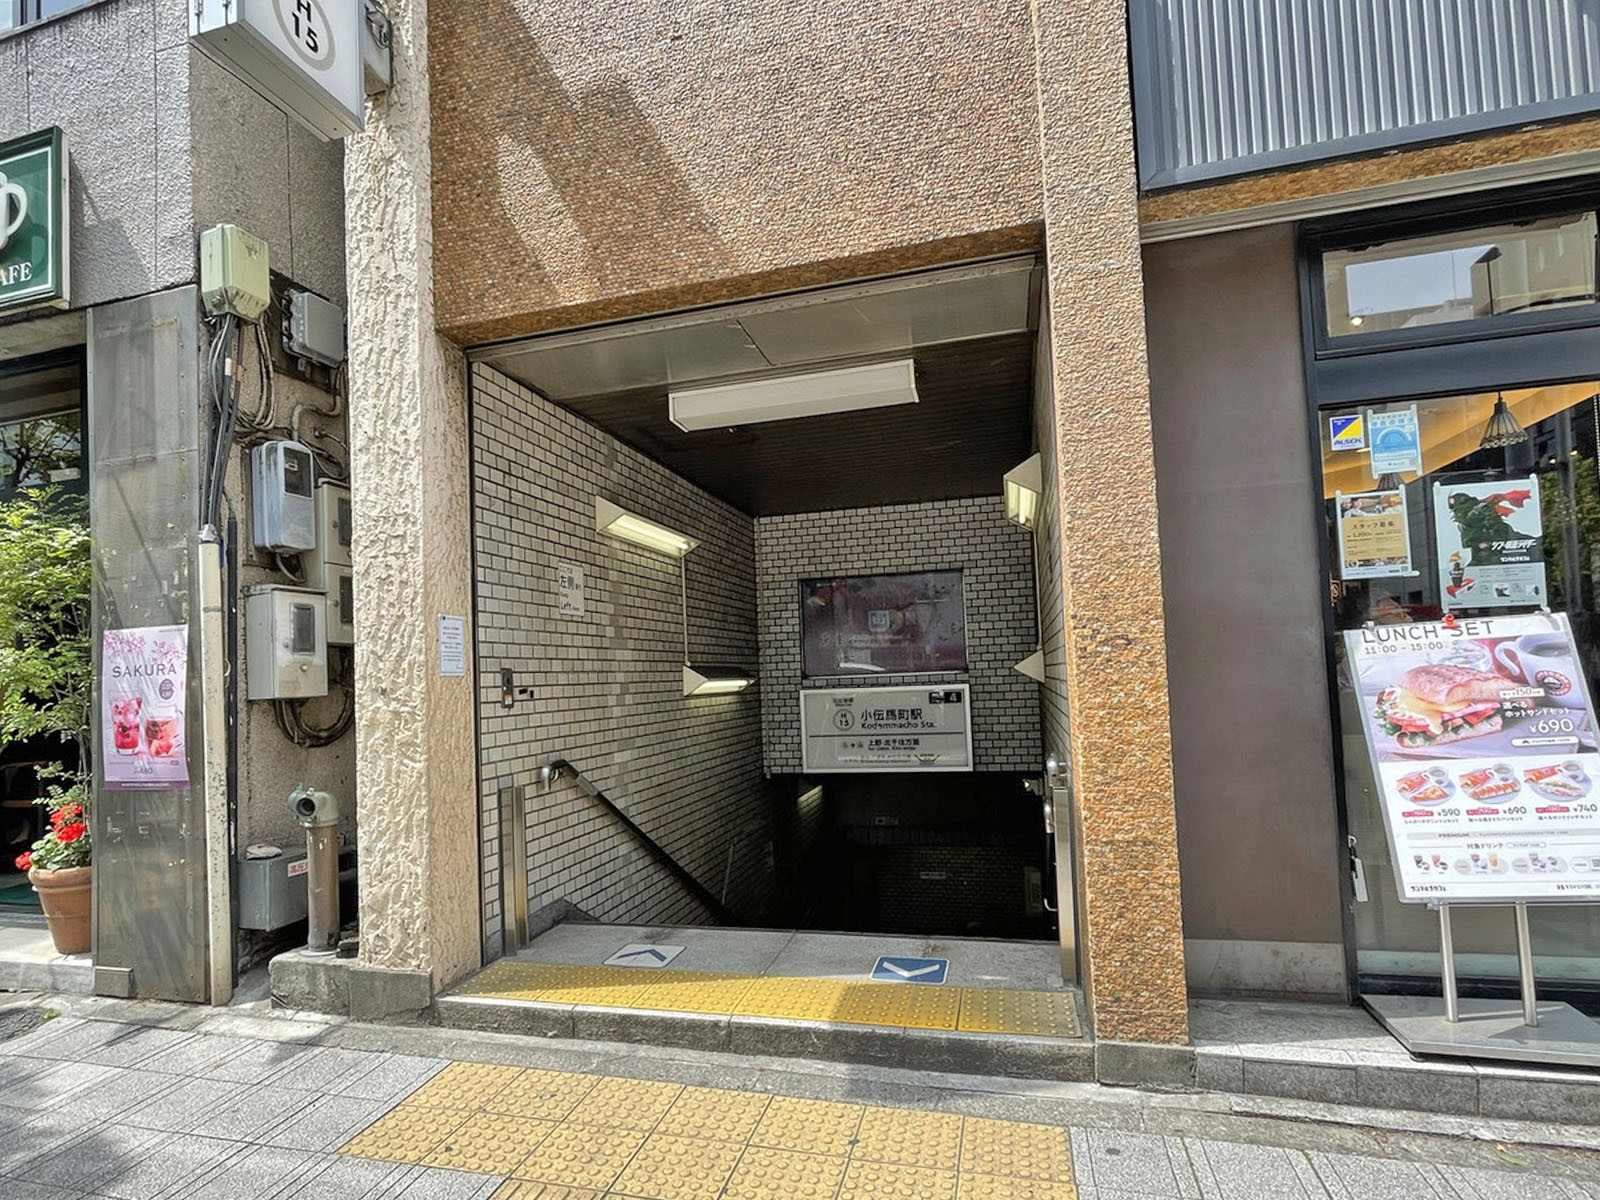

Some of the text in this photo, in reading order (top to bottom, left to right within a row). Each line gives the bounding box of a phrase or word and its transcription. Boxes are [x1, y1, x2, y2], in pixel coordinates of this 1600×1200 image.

[292, 11, 319, 54] 15
[1362, 625, 1438, 644] LUNCH
[1365, 644, 1398, 655] 11:00
[1410, 641, 1443, 652] 15:00
[112, 663, 177, 679] SAKURA
[860, 708, 923, 721] 小伝馬町駅
[839, 719, 850, 727] 15
[1529, 718, 1574, 734] ¥690
[1437, 808, 1461, 817] ¥590
[1502, 806, 1527, 815] ¥690
[1573, 803, 1598, 813] ¥740
